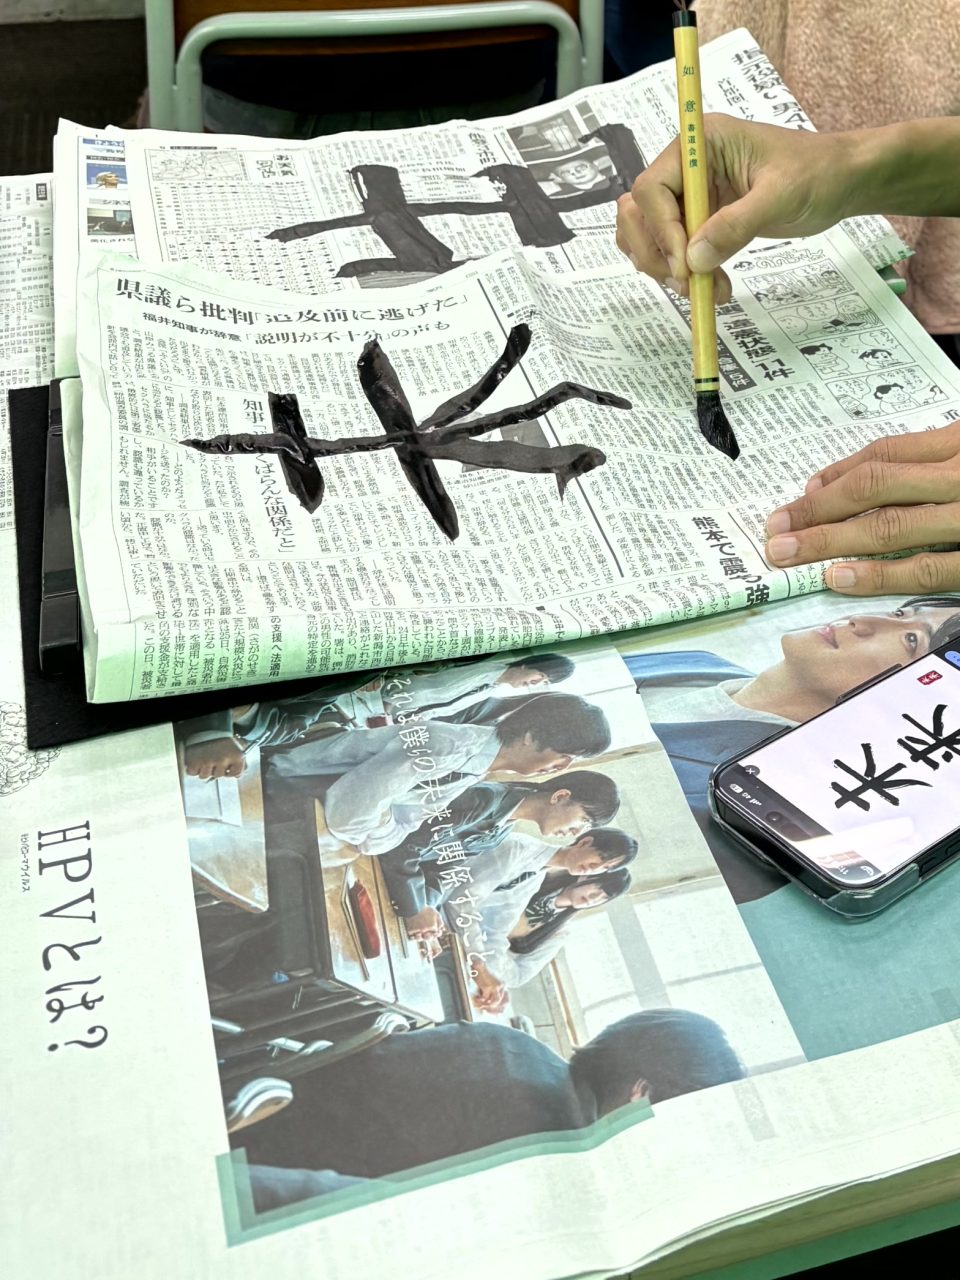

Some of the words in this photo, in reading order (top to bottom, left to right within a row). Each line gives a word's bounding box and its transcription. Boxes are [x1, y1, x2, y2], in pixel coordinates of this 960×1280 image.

[243, 398, 296, 554] 知事「くばらんな関係だと」
